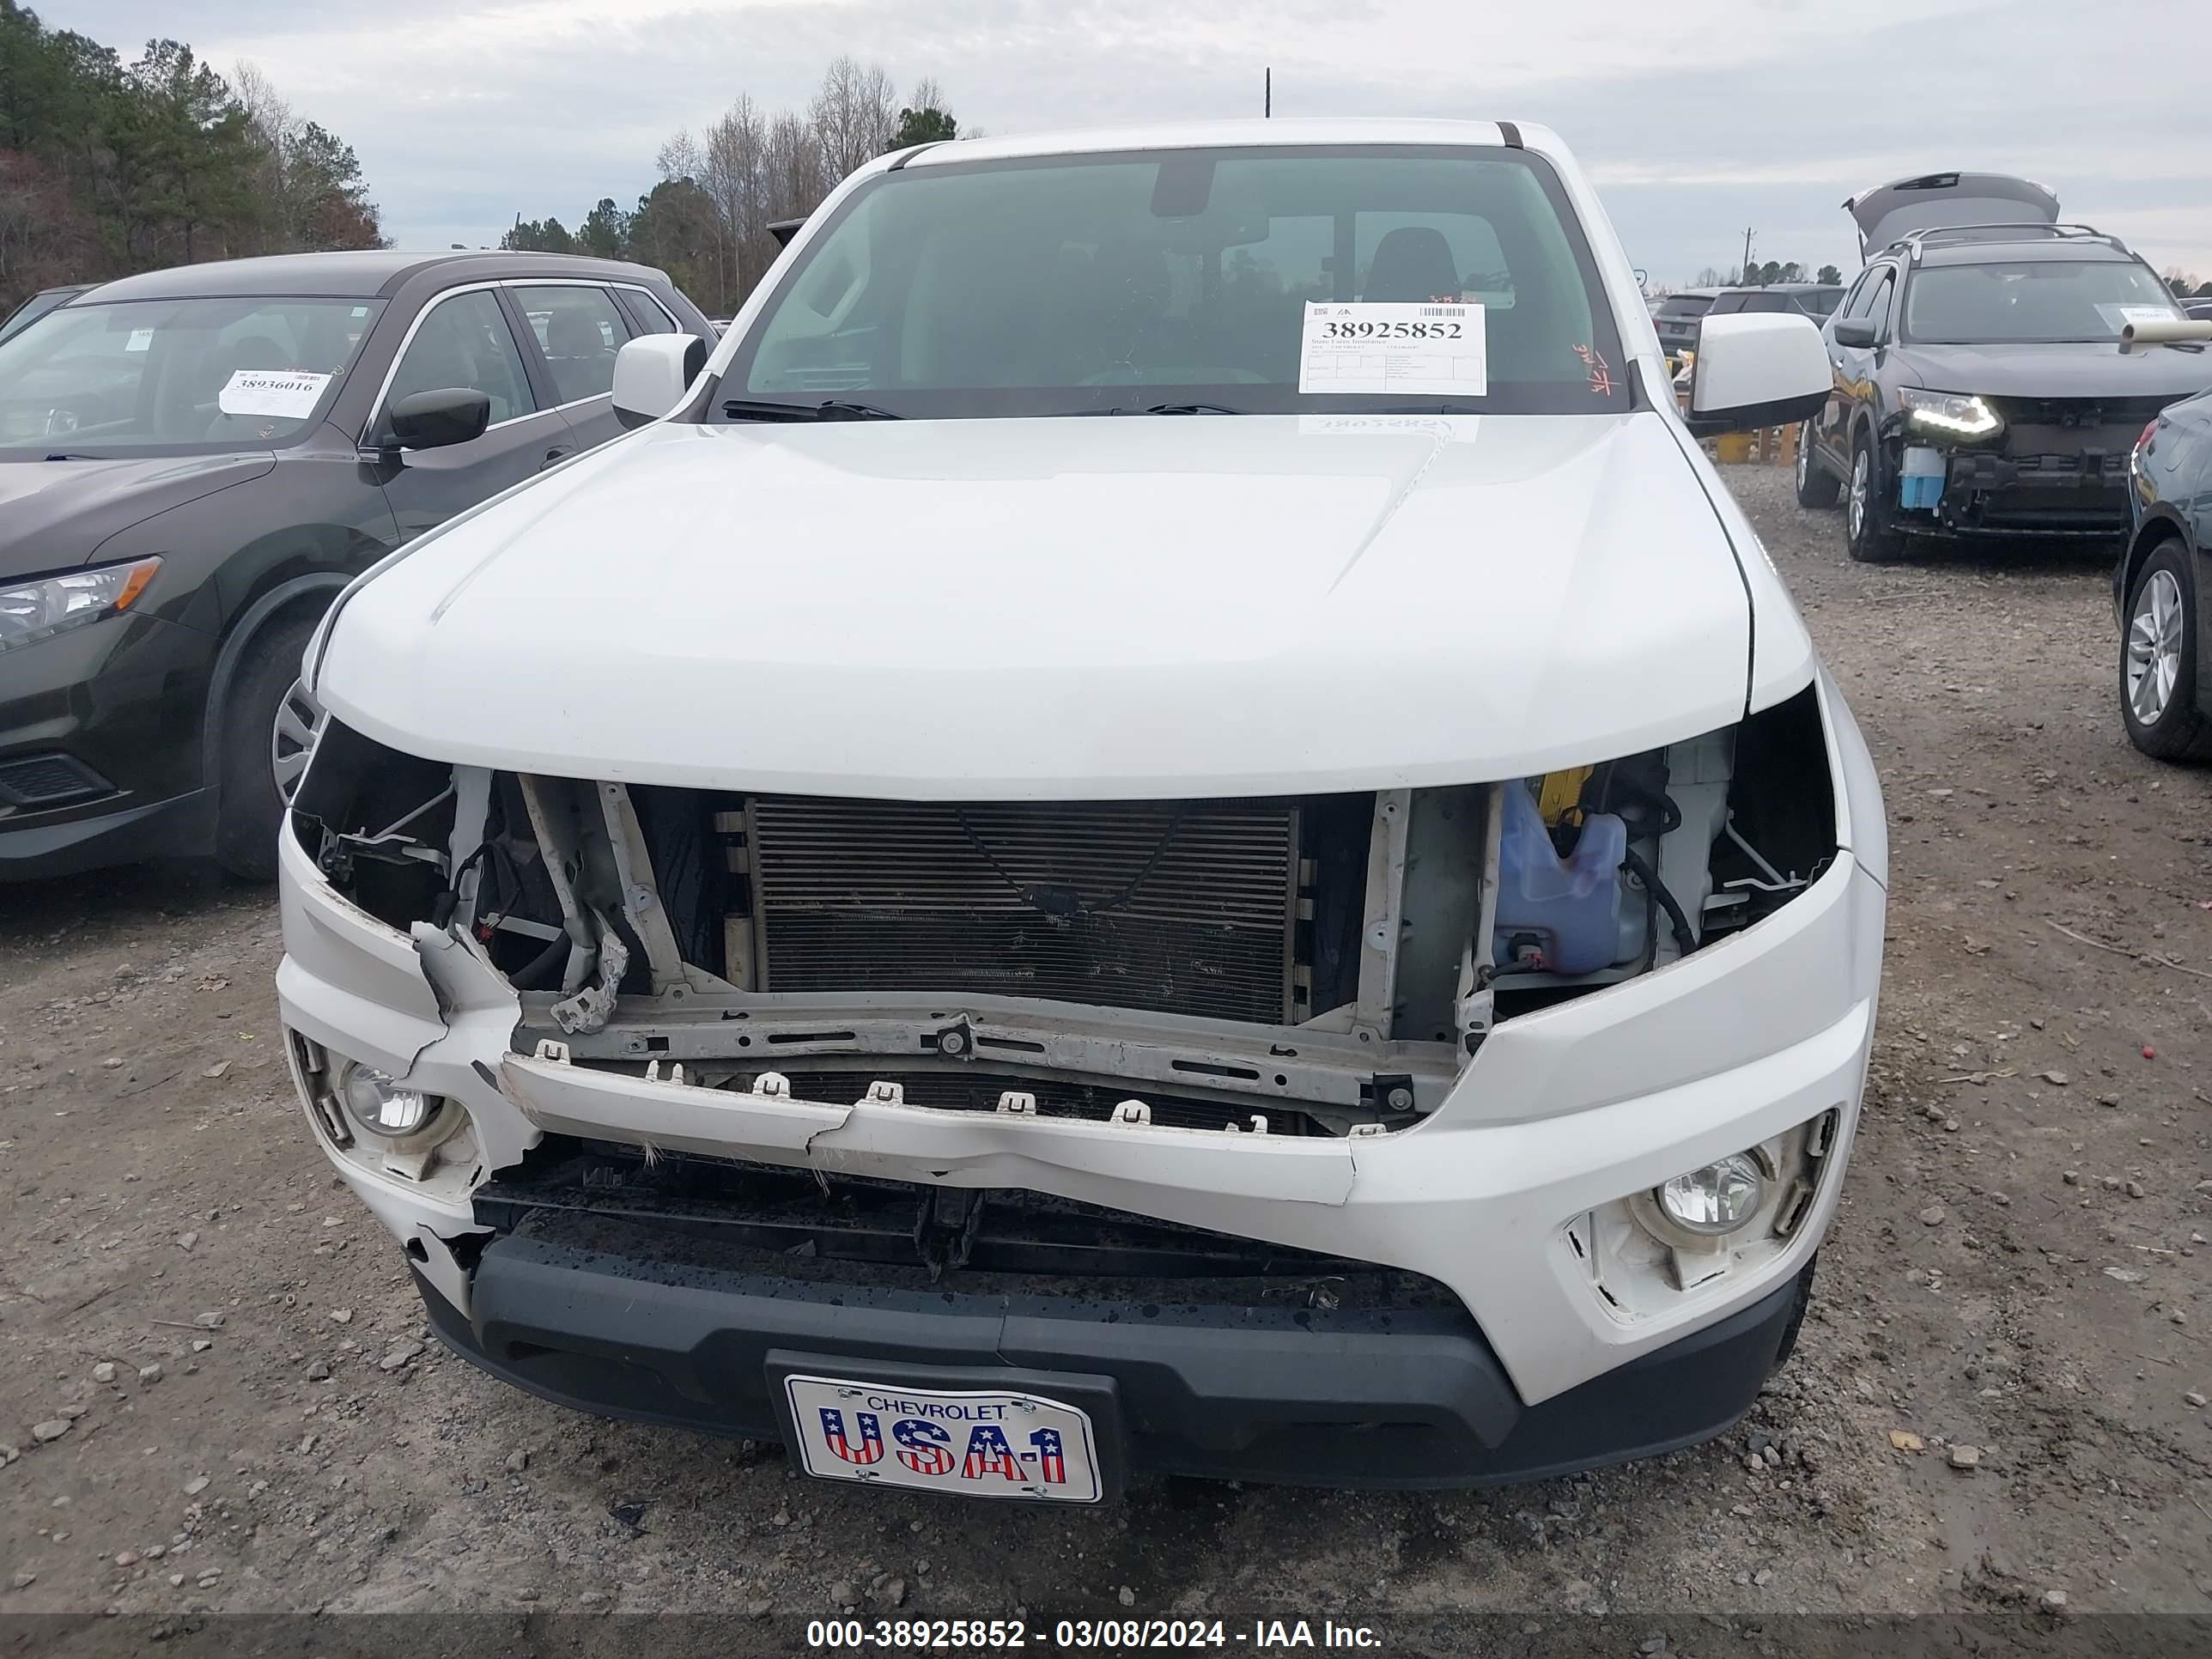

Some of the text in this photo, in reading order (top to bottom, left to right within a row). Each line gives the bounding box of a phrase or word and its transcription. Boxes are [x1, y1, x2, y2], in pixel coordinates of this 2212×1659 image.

[1322, 322, 1462, 339] 38925852
[237, 379, 315, 392] 38936016
[867, 1396, 1007, 1421] CHEVROLET
[817, 1407, 1067, 1485] USA-1
